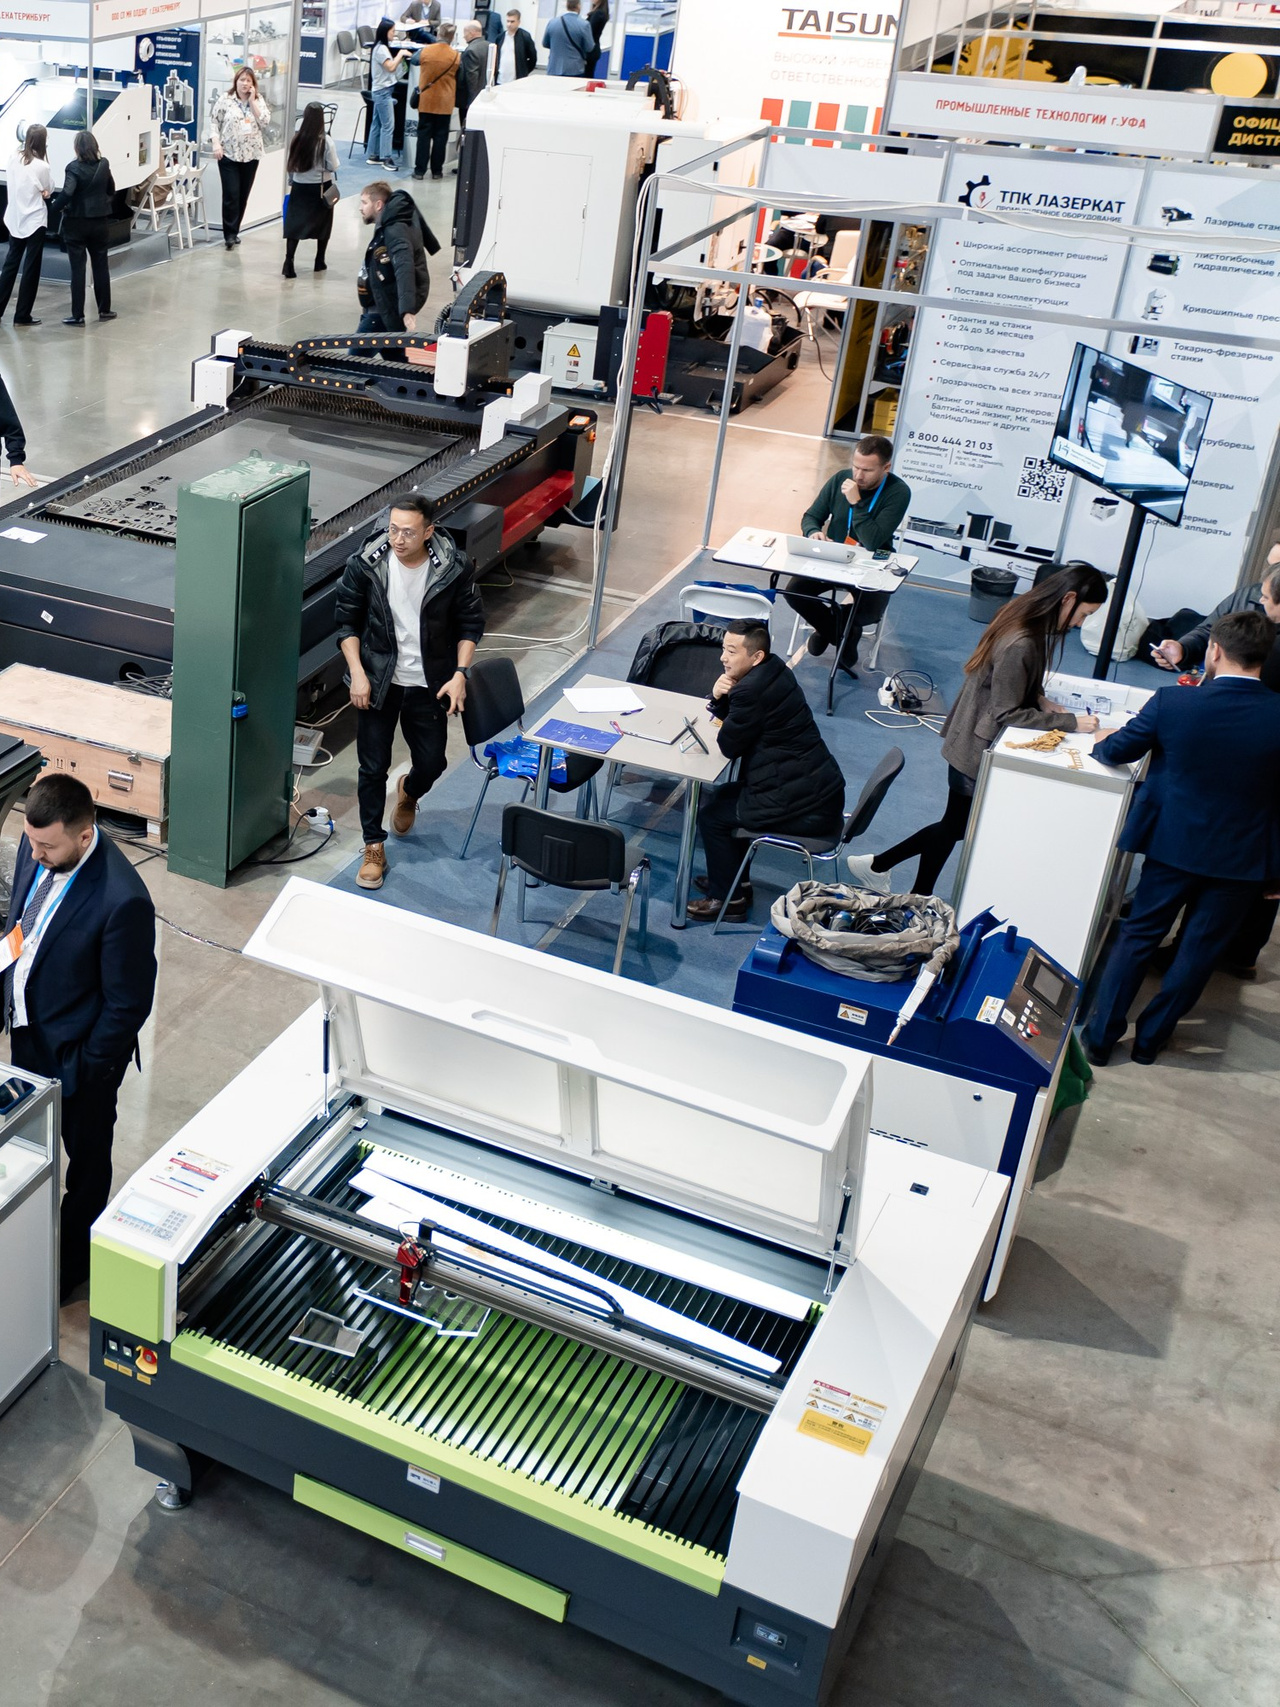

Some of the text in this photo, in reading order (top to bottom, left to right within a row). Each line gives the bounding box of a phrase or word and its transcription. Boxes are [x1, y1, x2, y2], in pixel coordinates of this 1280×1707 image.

[935, 99, 1031, 118] ПРОМЫШЛЕННЫЕ
[1035, 108, 1107, 125] ТЕХНОЛОГИИ
[1233, 116, 1280, 133] ОФИЦ
[999, 190, 1126, 214] ТПК ЛАЗЕРКАТ
[1061, 212, 1122, 224] ОБОРУДОВАНИЕ
[1204, 217, 1255, 229] Лазерные
[963, 240, 1108, 262] Широкий ассортимент решений
[959, 259, 1087, 279] Оптимальные конфигурации
[1193, 262, 1274, 277] гидравлические
[958, 269, 1081, 289] под задачи Вашего бизнеса
[954, 287, 994, 298] Поставка
[997, 292, 1069, 306] комплектующих
[1183, 304, 1253, 319] Кривошипные
[949, 314, 987, 325] Гарантия
[1002, 322, 1032, 330] станки
[997, 330, 1034, 340] месяцев
[944, 342, 1025, 357] Контроль качества
[1175, 343, 1274, 361] Токарно-фрезерные
[1171, 354, 1203, 363] станки
[993, 367, 1026, 377] служба
[1029, 371, 1050, 379] 24/7
[937, 377, 996, 391] Прозрачность
[1012, 388, 1031, 396] всех
[1034, 391, 1062, 400] этапах
[931, 403, 980, 416] Балтийский
[982, 411, 1012, 421] лизинг,
[1015, 415, 1028, 423] МК
[933, 394, 962, 404] Лизинг
[976, 401, 1003, 410] наших
[1006, 404, 1054, 417] партнеров:
[1000, 423, 1030, 432] других
[909, 431, 993, 451] 8 800 444 21 03
[901, 472, 982, 491] www.lasercupcut.ru
[1191, 479, 1234, 491] маркеры
[1184, 524, 1231, 537] аппараты
